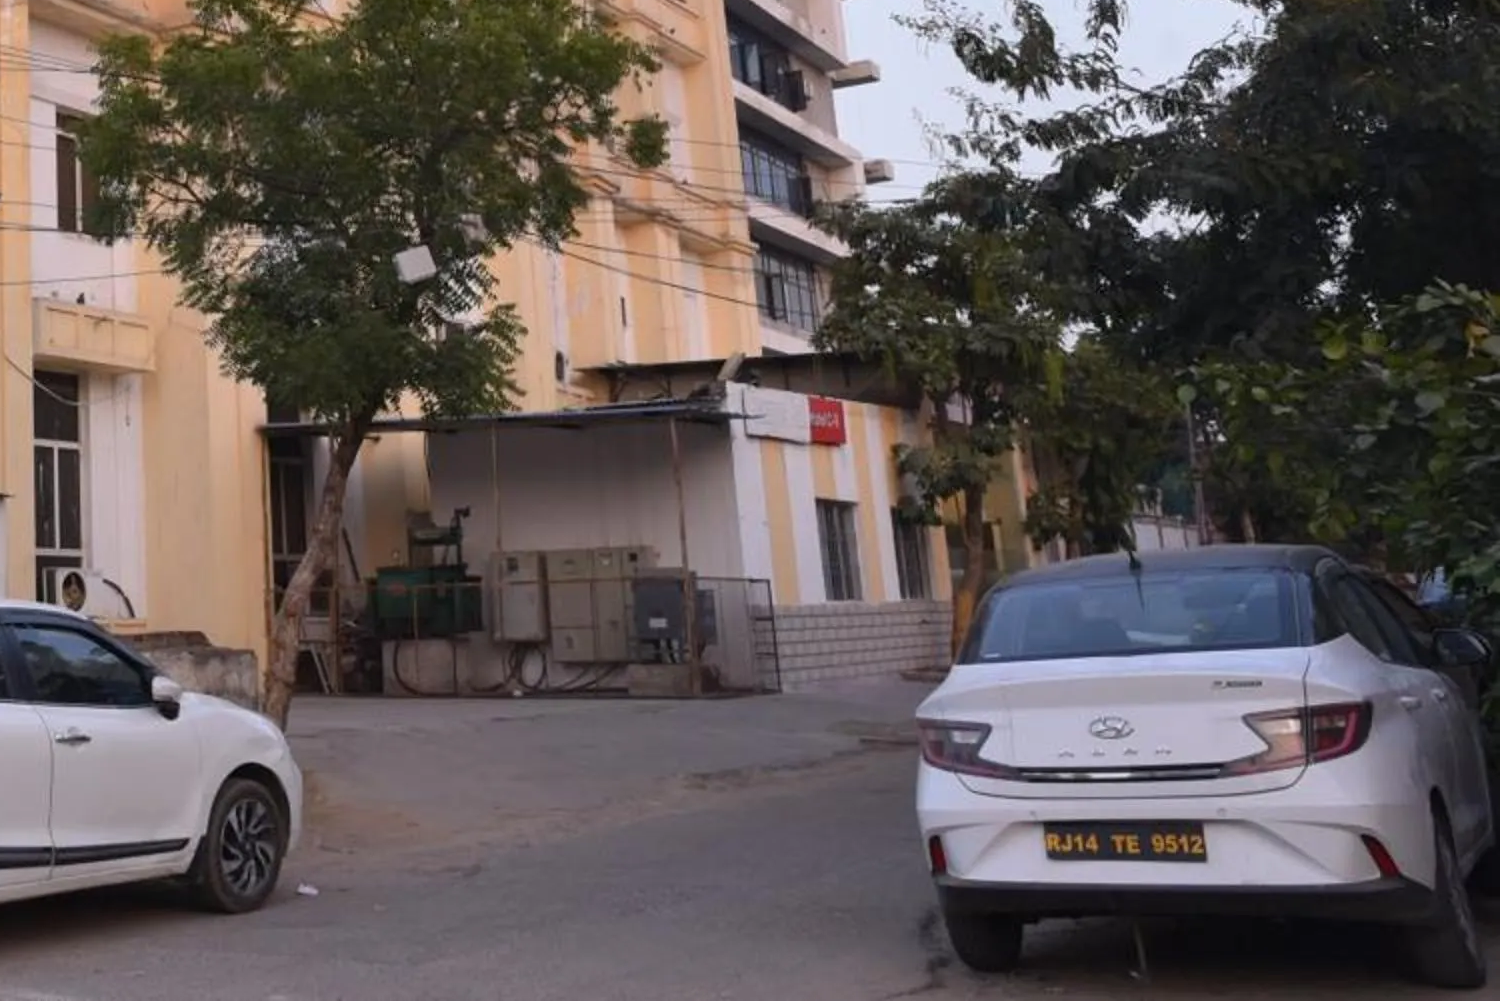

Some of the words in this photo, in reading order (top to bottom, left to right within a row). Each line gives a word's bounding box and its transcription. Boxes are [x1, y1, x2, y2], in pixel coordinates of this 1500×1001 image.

[1046, 832, 1099, 854] RJ14
[1111, 833, 1141, 854] TE
[1151, 833, 1205, 855] 9512
